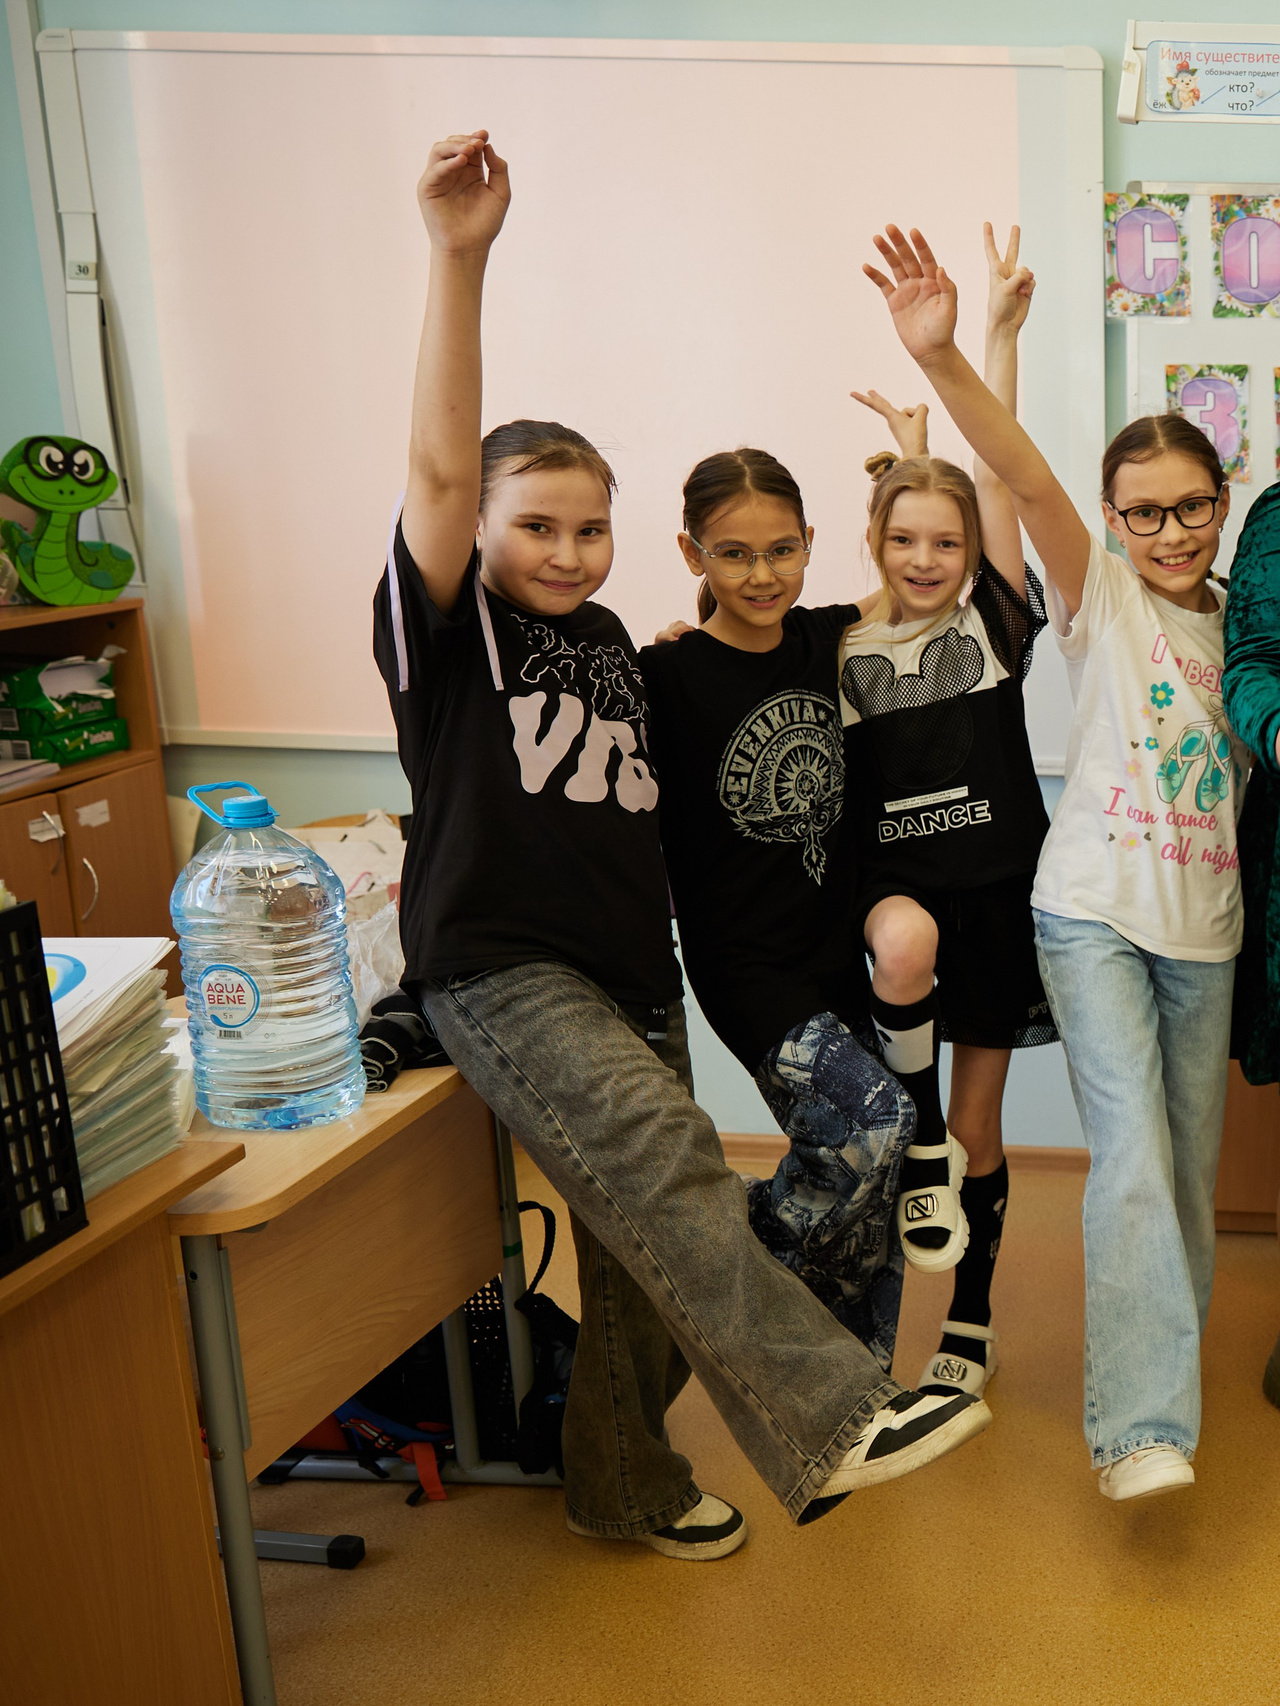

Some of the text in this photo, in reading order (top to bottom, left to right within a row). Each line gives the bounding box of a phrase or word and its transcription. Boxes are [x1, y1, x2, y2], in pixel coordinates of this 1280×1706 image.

[1160, 47, 1192, 62] Имя
[1205, 68, 1279, 79] обозначает предмет
[1228, 82, 1255, 93] кто?
[1228, 100, 1255, 111] что?
[75, 264, 89, 276] 30
[1184, 659, 1223, 693] Ba
[726, 700, 818, 795] EVENKIYA
[1103, 786, 1219, 832] I can dance
[878, 800, 992, 842] DANCE
[1161, 835, 1239, 875] all nigh
[206, 983, 245, 993] AQUA
[207, 994, 246, 1005] BENE
